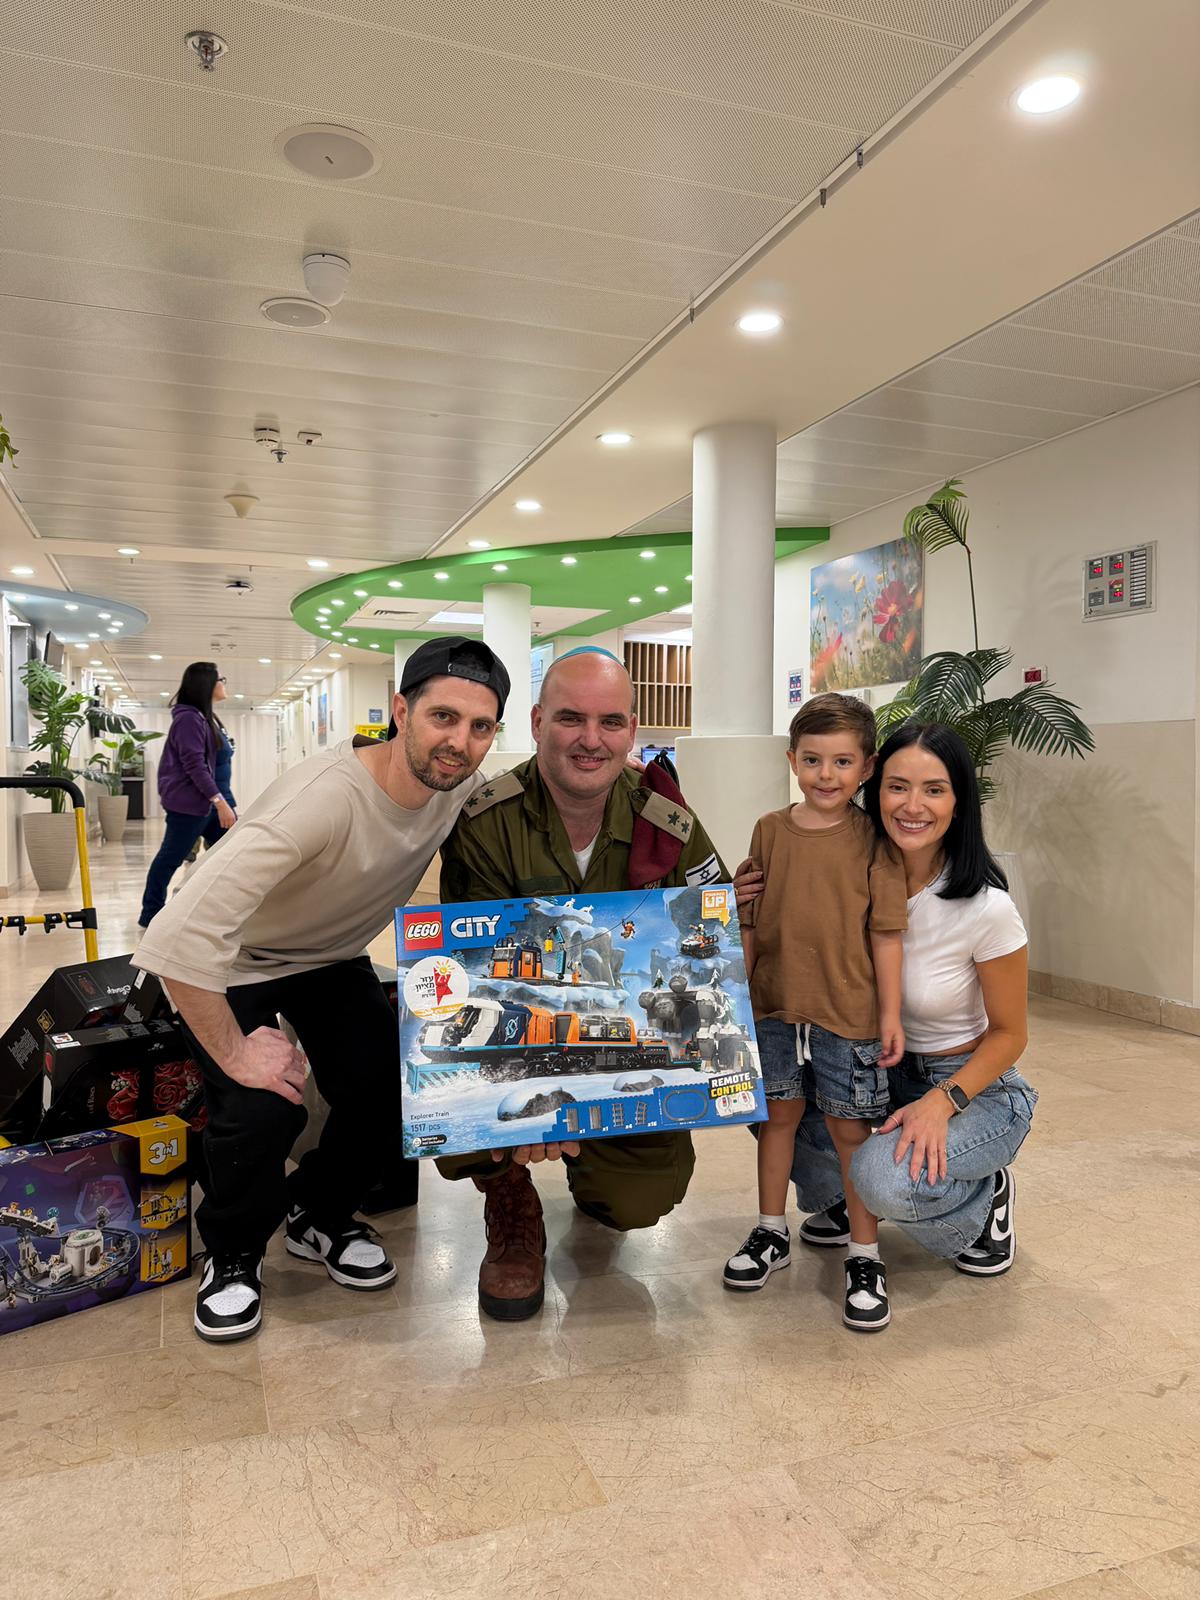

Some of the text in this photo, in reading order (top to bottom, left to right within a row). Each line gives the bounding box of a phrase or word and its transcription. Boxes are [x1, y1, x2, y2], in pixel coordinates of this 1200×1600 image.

[406, 921, 441, 940] LEGO
[711, 1072, 751, 1088] REMOTE
[710, 1081, 754, 1098] CONTROL
[410, 1113, 434, 1121] Explorer
[410, 1123, 441, 1133] 1517 pcs
